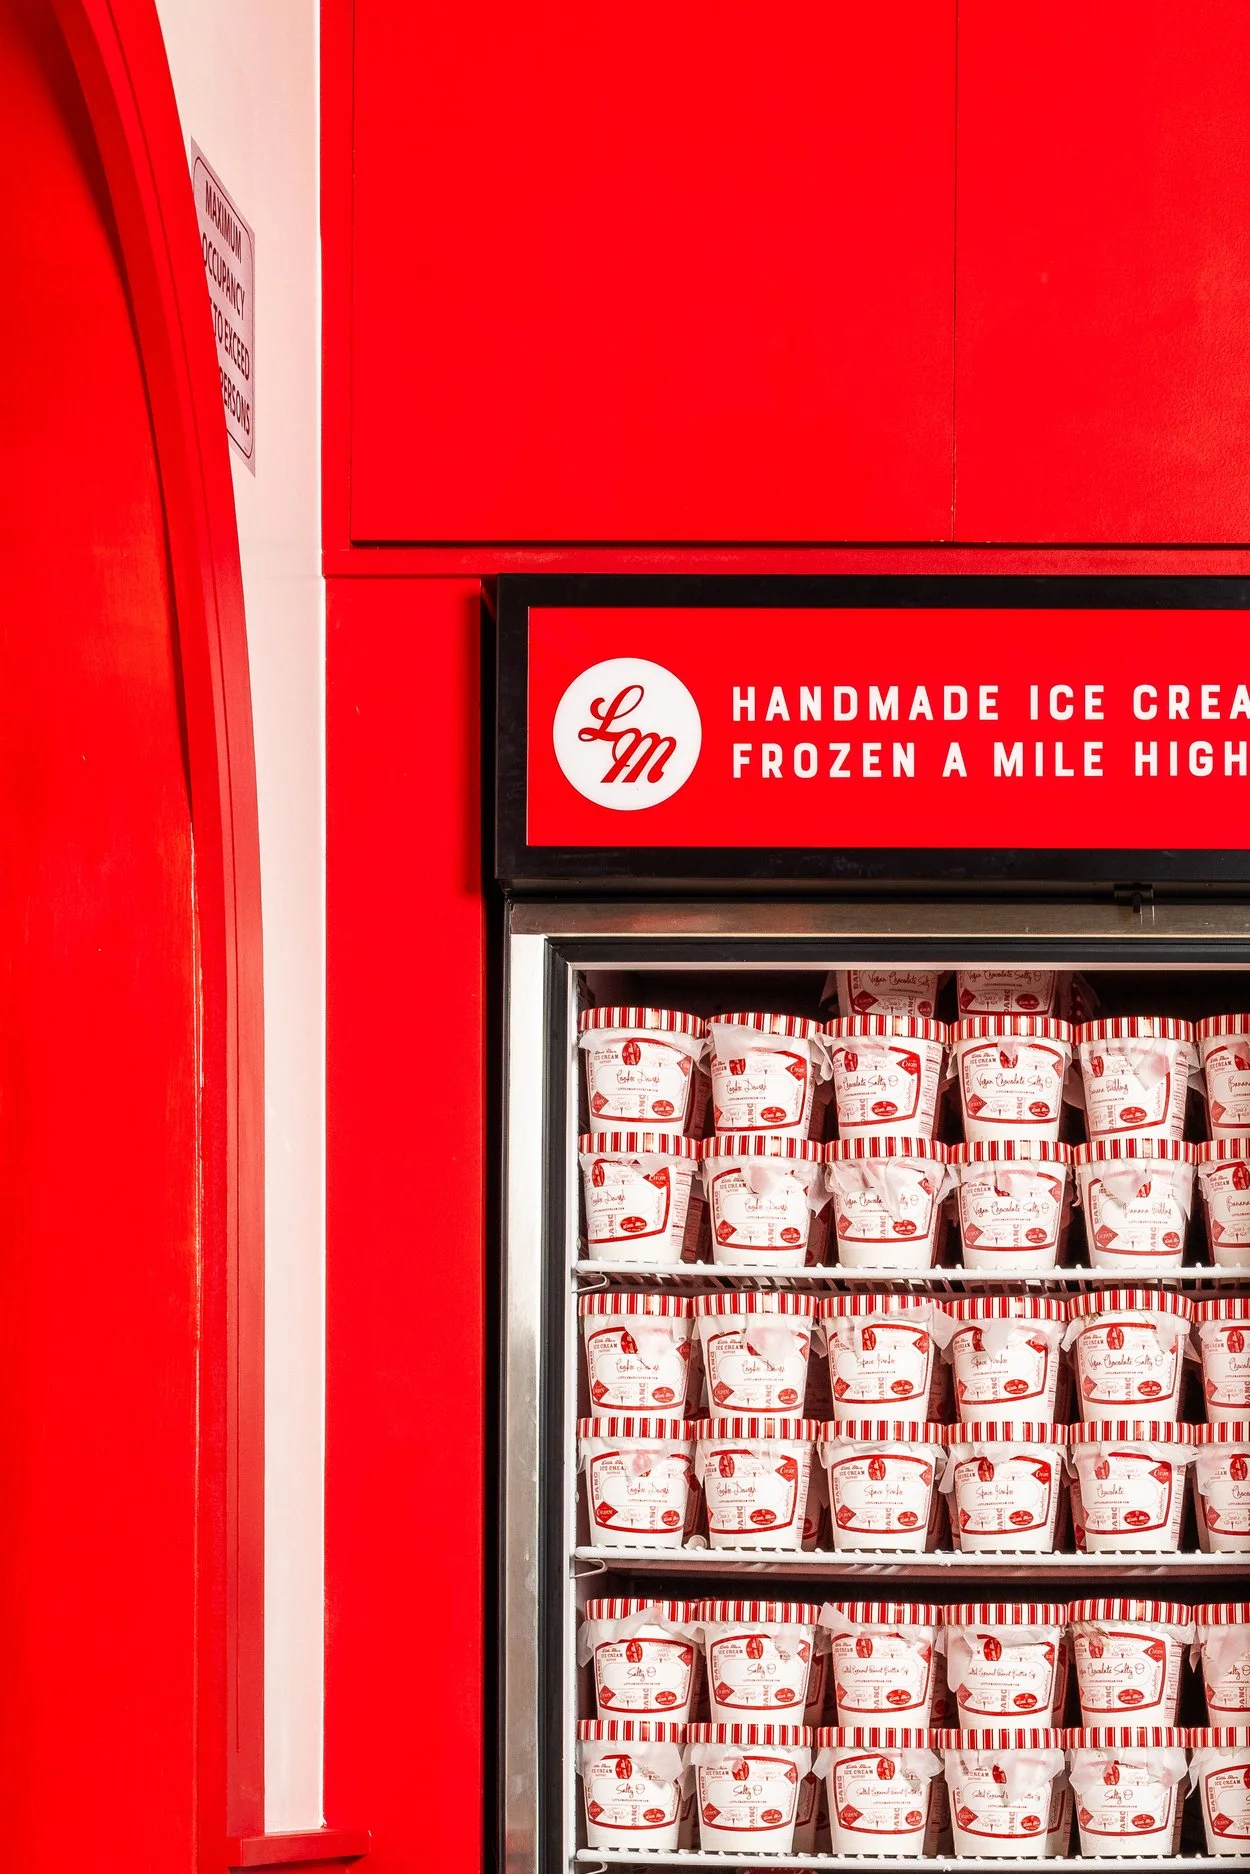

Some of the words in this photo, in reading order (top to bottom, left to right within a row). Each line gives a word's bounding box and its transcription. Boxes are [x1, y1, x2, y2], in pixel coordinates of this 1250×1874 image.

[206, 180, 242, 264] MAXIMUM
[202, 232, 245, 320] OCCUPANCY
[224, 318, 249, 381] EXCEED
[731, 685, 999, 722] HANDMADE
[1029, 684, 1104, 721] ICE
[732, 741, 917, 779] FROZEN
[942, 742, 969, 779] A
[993, 740, 1104, 778] MILE
